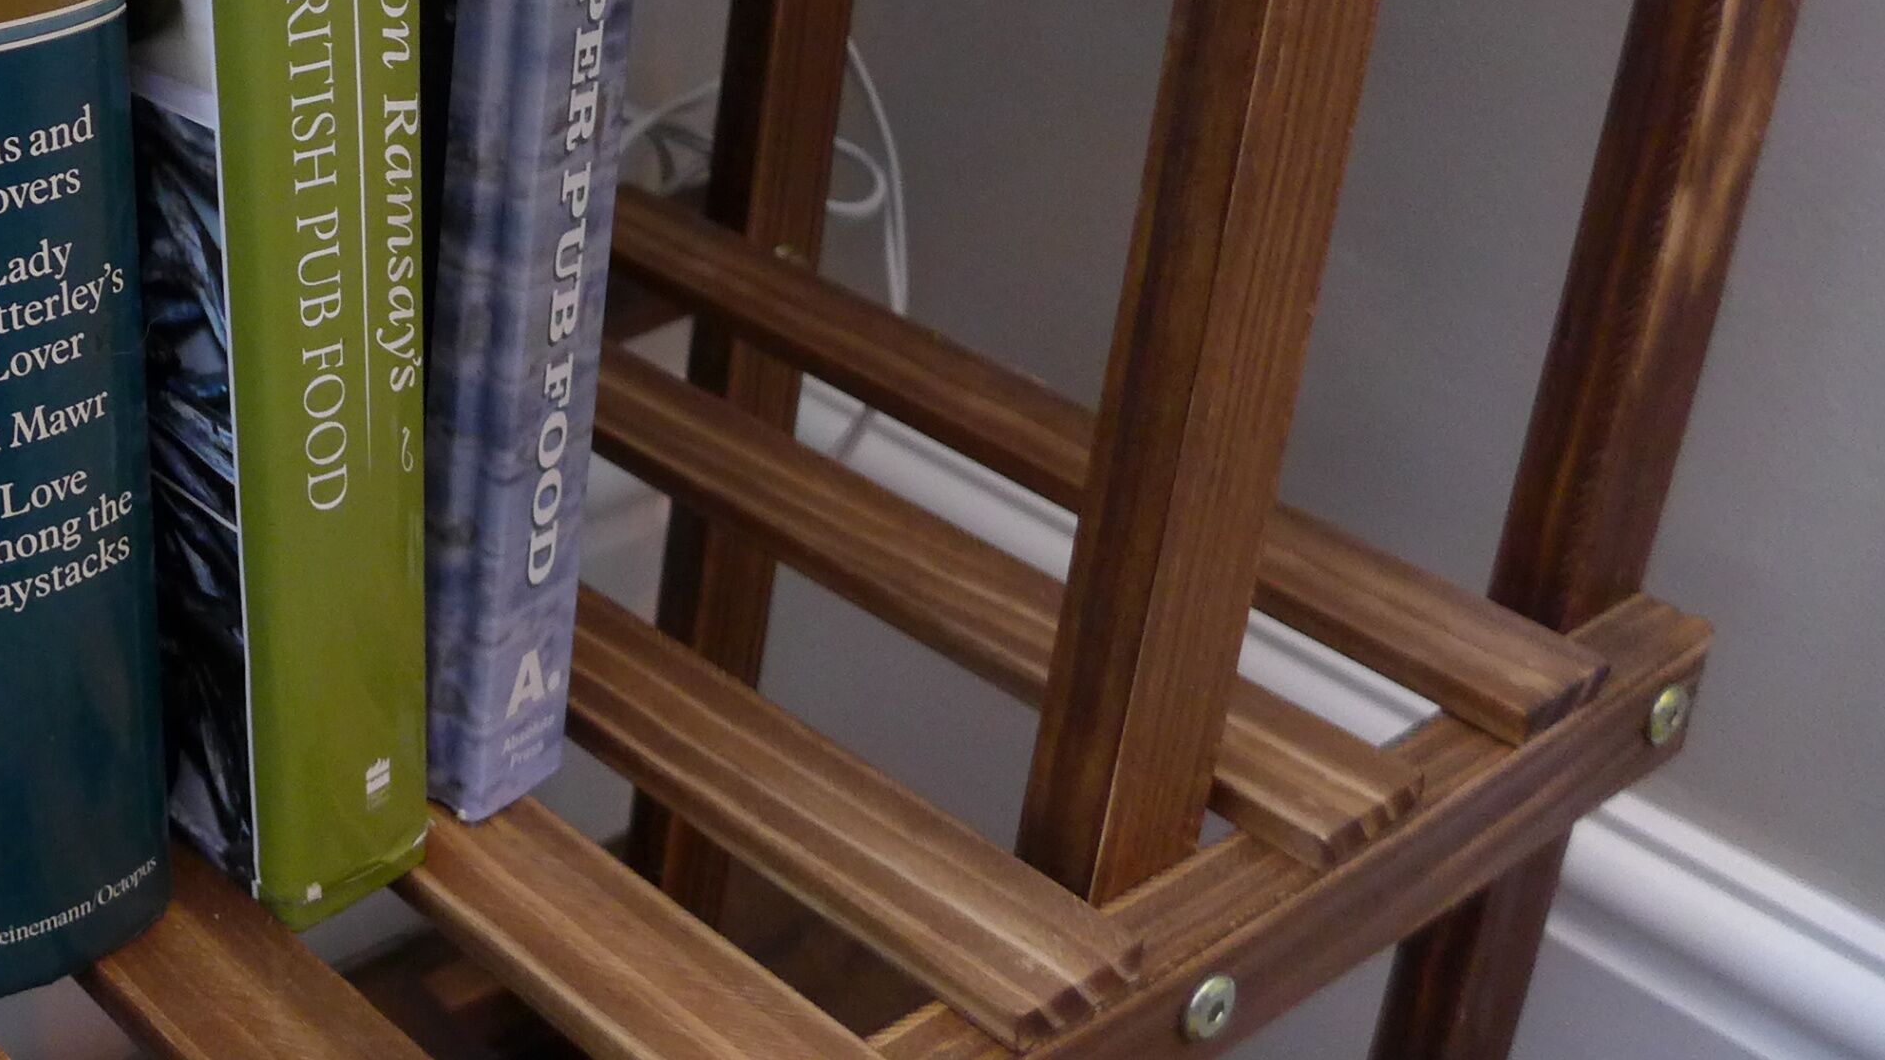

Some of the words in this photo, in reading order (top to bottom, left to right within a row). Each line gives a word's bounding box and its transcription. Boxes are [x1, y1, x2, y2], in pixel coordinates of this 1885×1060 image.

[28, 102, 95, 157] and
[296, 207, 343, 328] PUB
[377, 92, 422, 393] Ramsay's
[547, 162, 593, 345] PUB
[9, 391, 108, 449] Mawr
[301, 338, 348, 512] FOOD
[527, 352, 575, 587] FOOD
[87, 490, 133, 533] the
